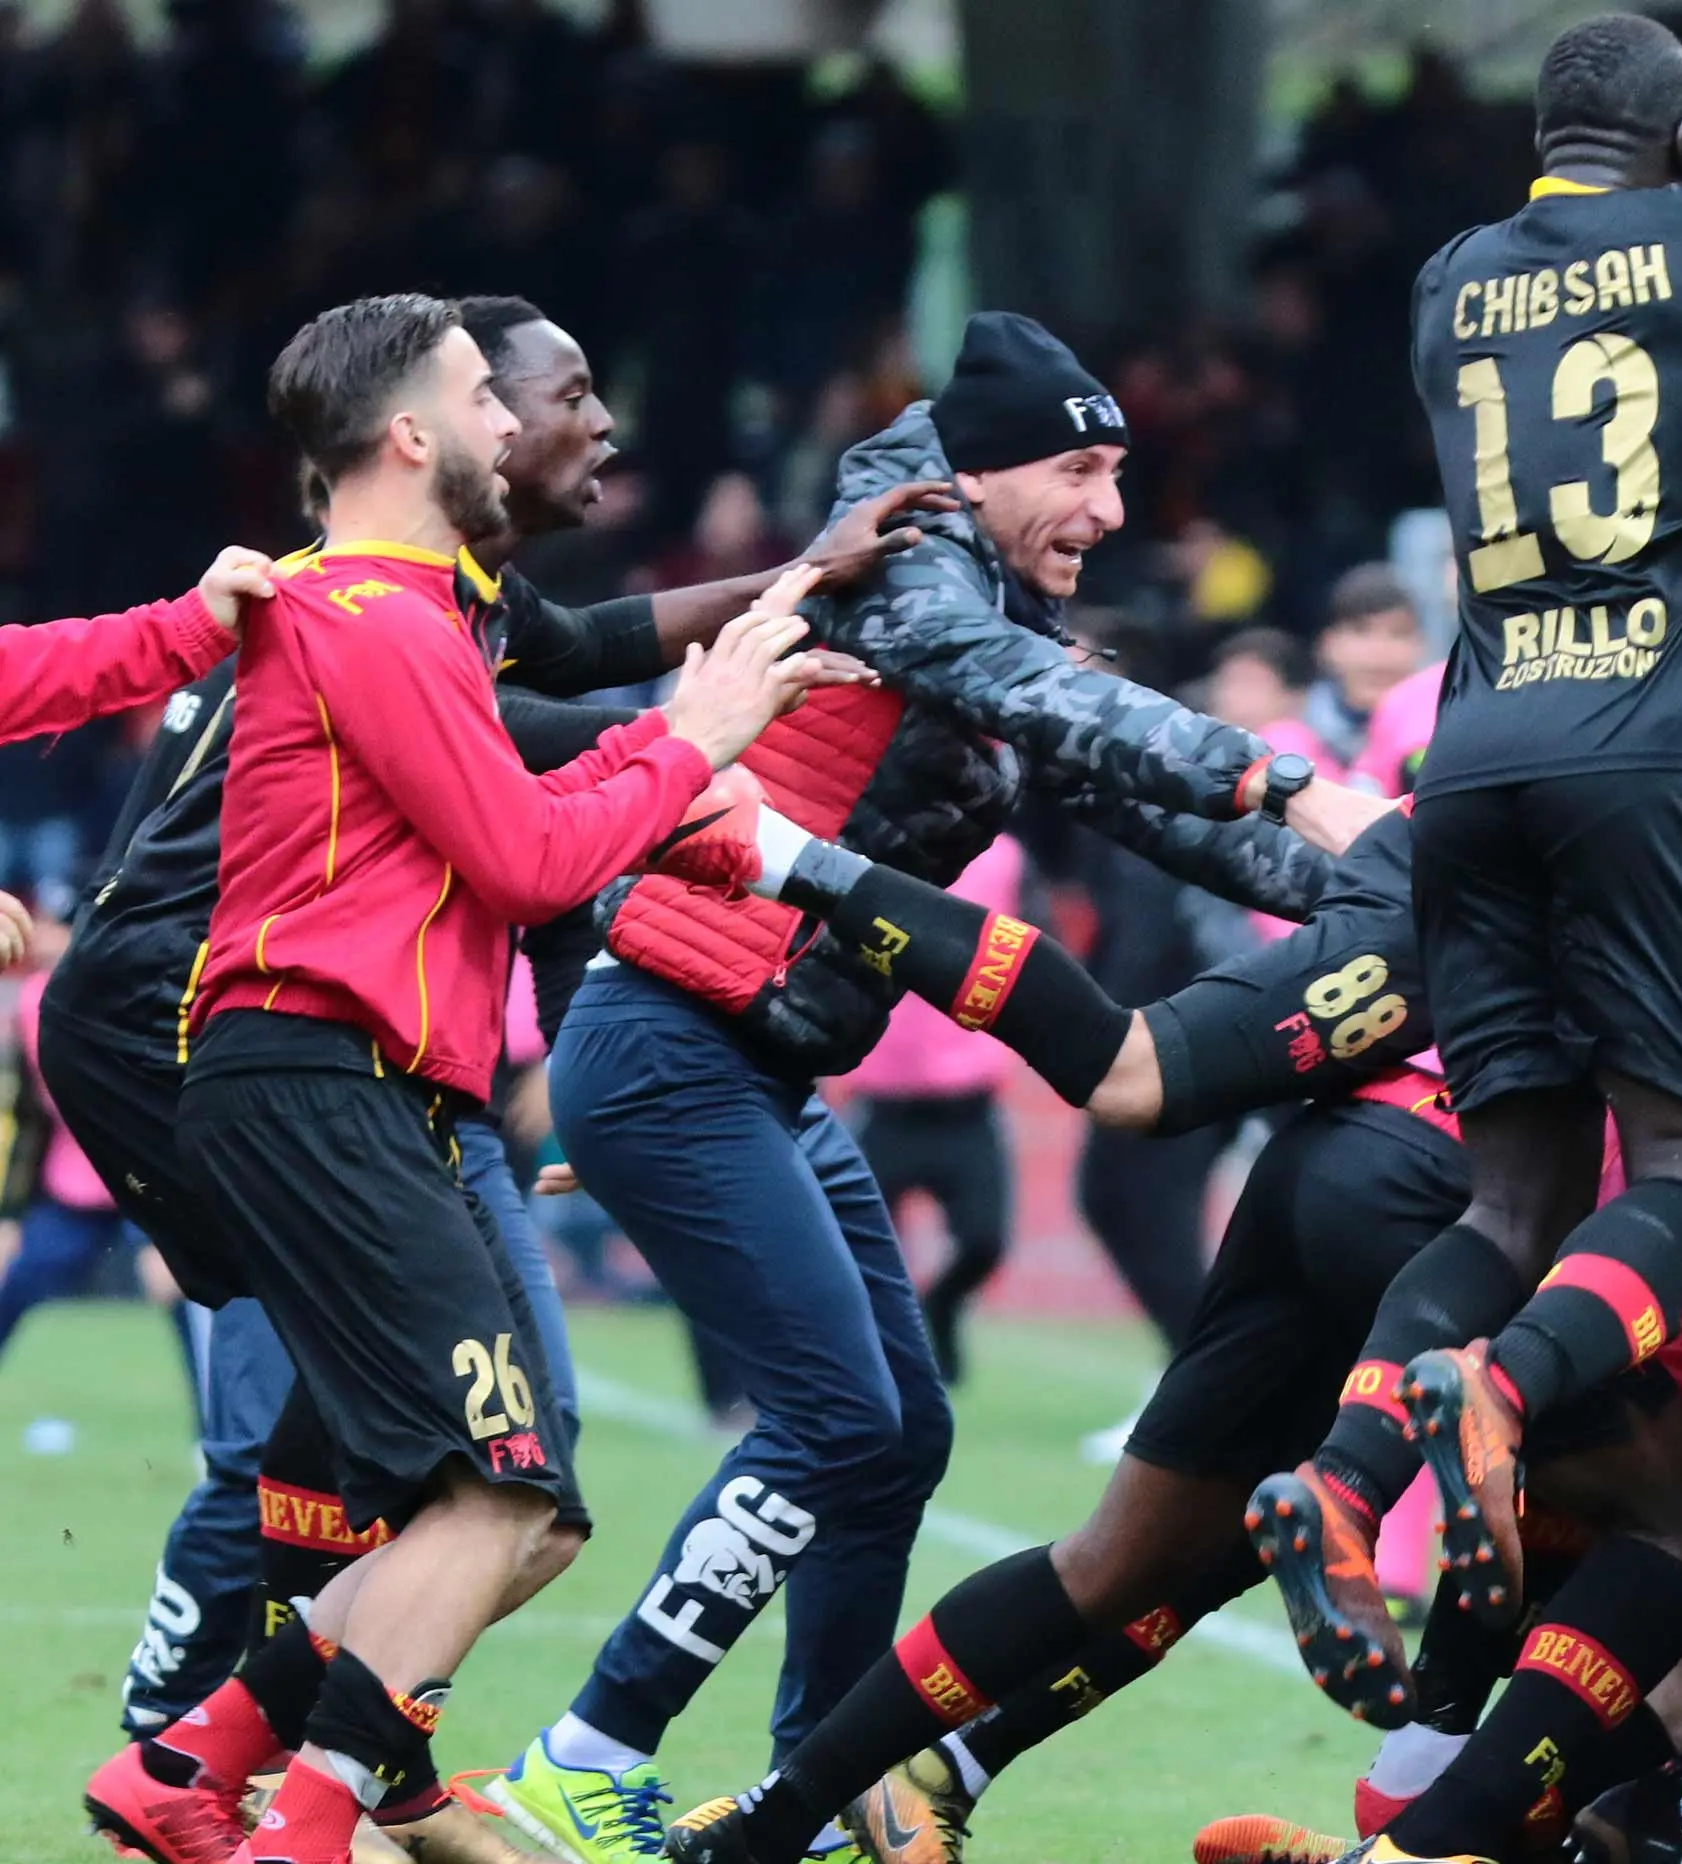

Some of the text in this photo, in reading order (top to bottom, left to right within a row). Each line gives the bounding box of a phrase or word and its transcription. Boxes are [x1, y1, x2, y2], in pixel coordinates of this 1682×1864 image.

[1453, 243, 1673, 340] CHIBSAH
[1456, 333, 1661, 594] 13
[1501, 597, 1667, 666] RILLO
[1304, 953, 1408, 1059] 88
[451, 1332, 535, 1440] 26
